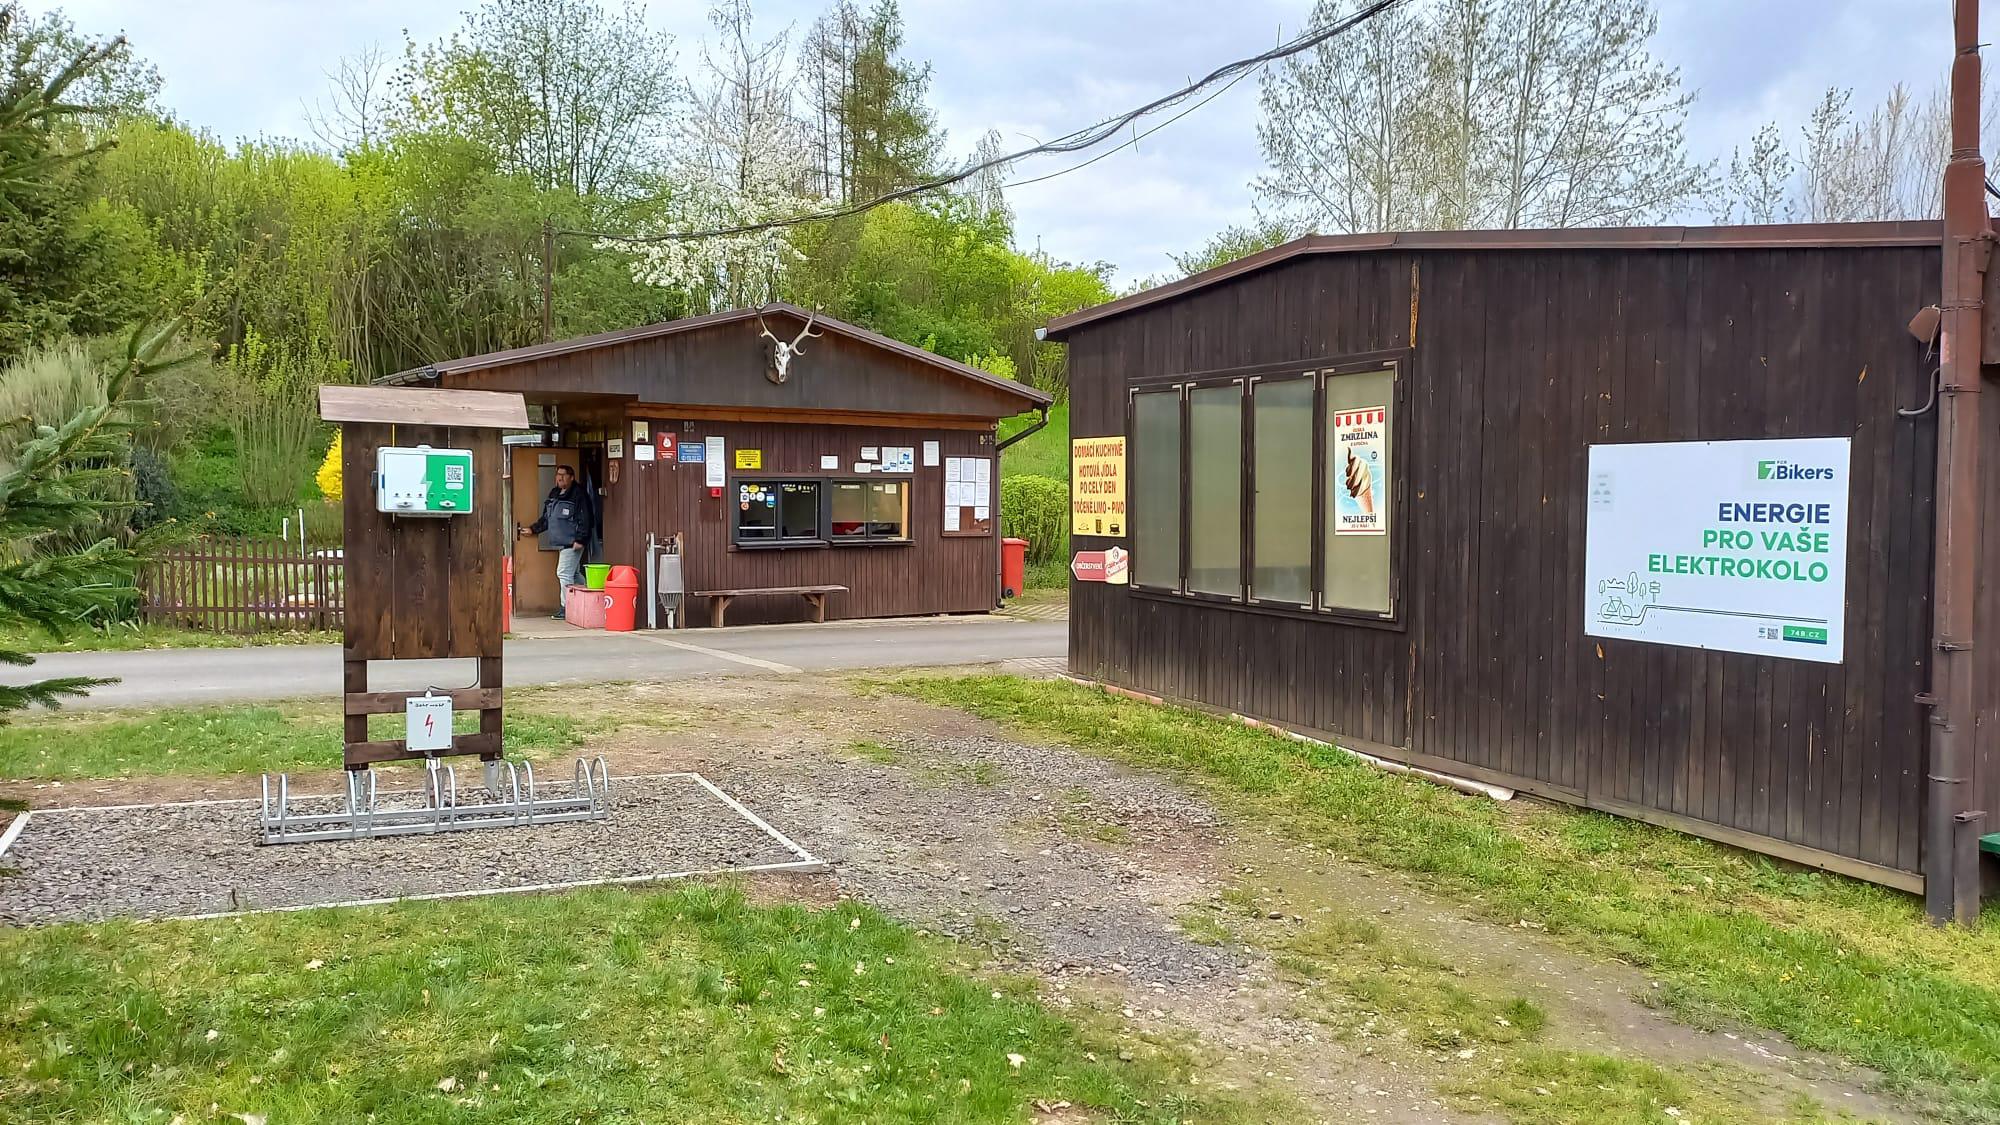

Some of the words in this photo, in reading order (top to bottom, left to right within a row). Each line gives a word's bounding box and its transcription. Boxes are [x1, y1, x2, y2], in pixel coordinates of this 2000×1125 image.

[1341, 431, 1378, 441] ZMRZLINA
[1074, 441, 1095, 458] DOMÁCÍ
[1096, 440, 1123, 457] KUCHYNĚ
[1079, 461, 1100, 478] HOTOVÁ
[1101, 460, 1117, 478] JÍDLA
[1777, 464, 1833, 480] Bikers
[1080, 481, 1087, 494] PO
[1088, 478, 1102, 494] CELÝ
[1104, 481, 1117, 494] DEN
[1074, 498, 1093, 514] TOČENÉ
[1094, 501, 1107, 514] LIMO
[1112, 501, 1125, 514] PIVO
[1719, 503, 1830, 524] ENERGIE
[1343, 513, 1377, 523] NEJLEPŠÍ
[1703, 529, 1754, 550] PRO
[1760, 527, 1829, 553] VAŠE
[1649, 554, 1828, 582] ELEKTROKOLO
